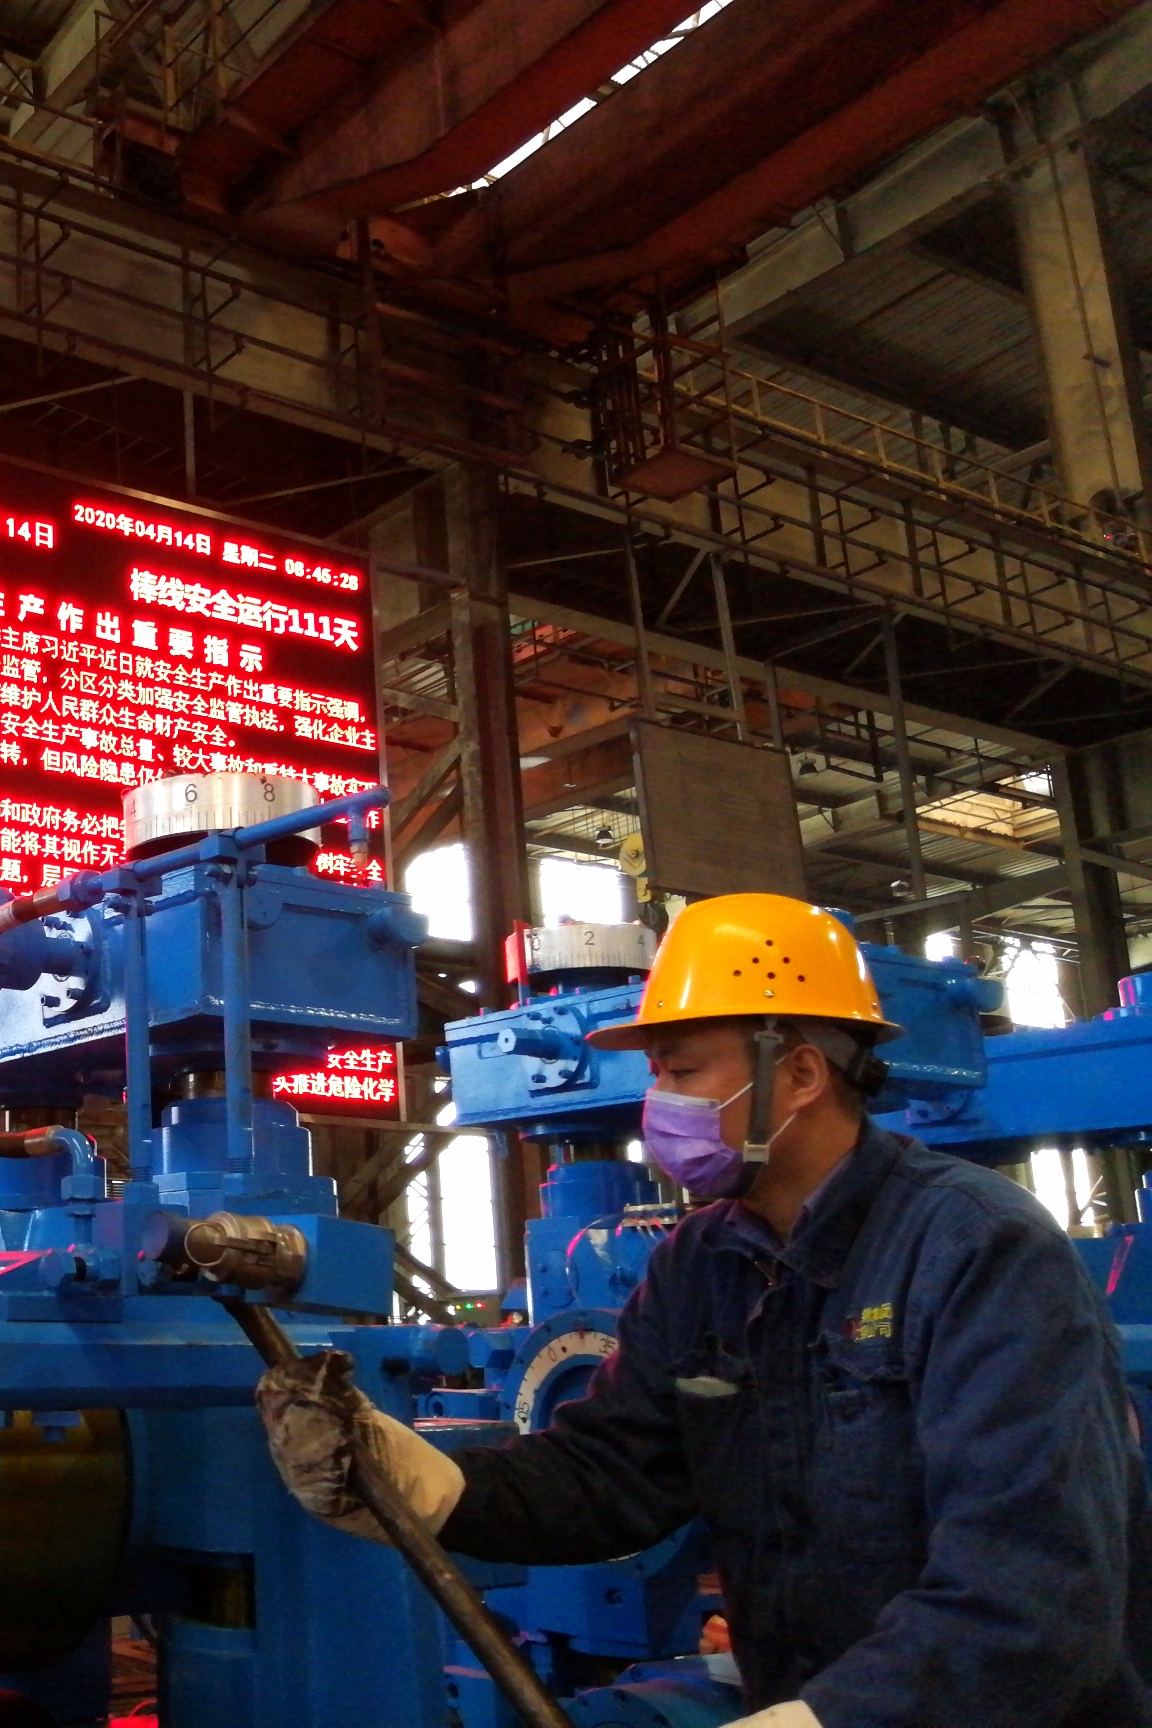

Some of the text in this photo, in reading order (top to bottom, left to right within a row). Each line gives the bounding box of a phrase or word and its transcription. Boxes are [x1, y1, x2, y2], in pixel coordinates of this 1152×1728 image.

[74, 504, 211, 556] 2020年04月14日
[222, 541, 277, 571] 星期二
[129, 567, 359, 652] 棒线安全运行111天
[184, 783, 198, 803] 6
[263, 782, 276, 803] 8
[583, 930, 596, 946] 2
